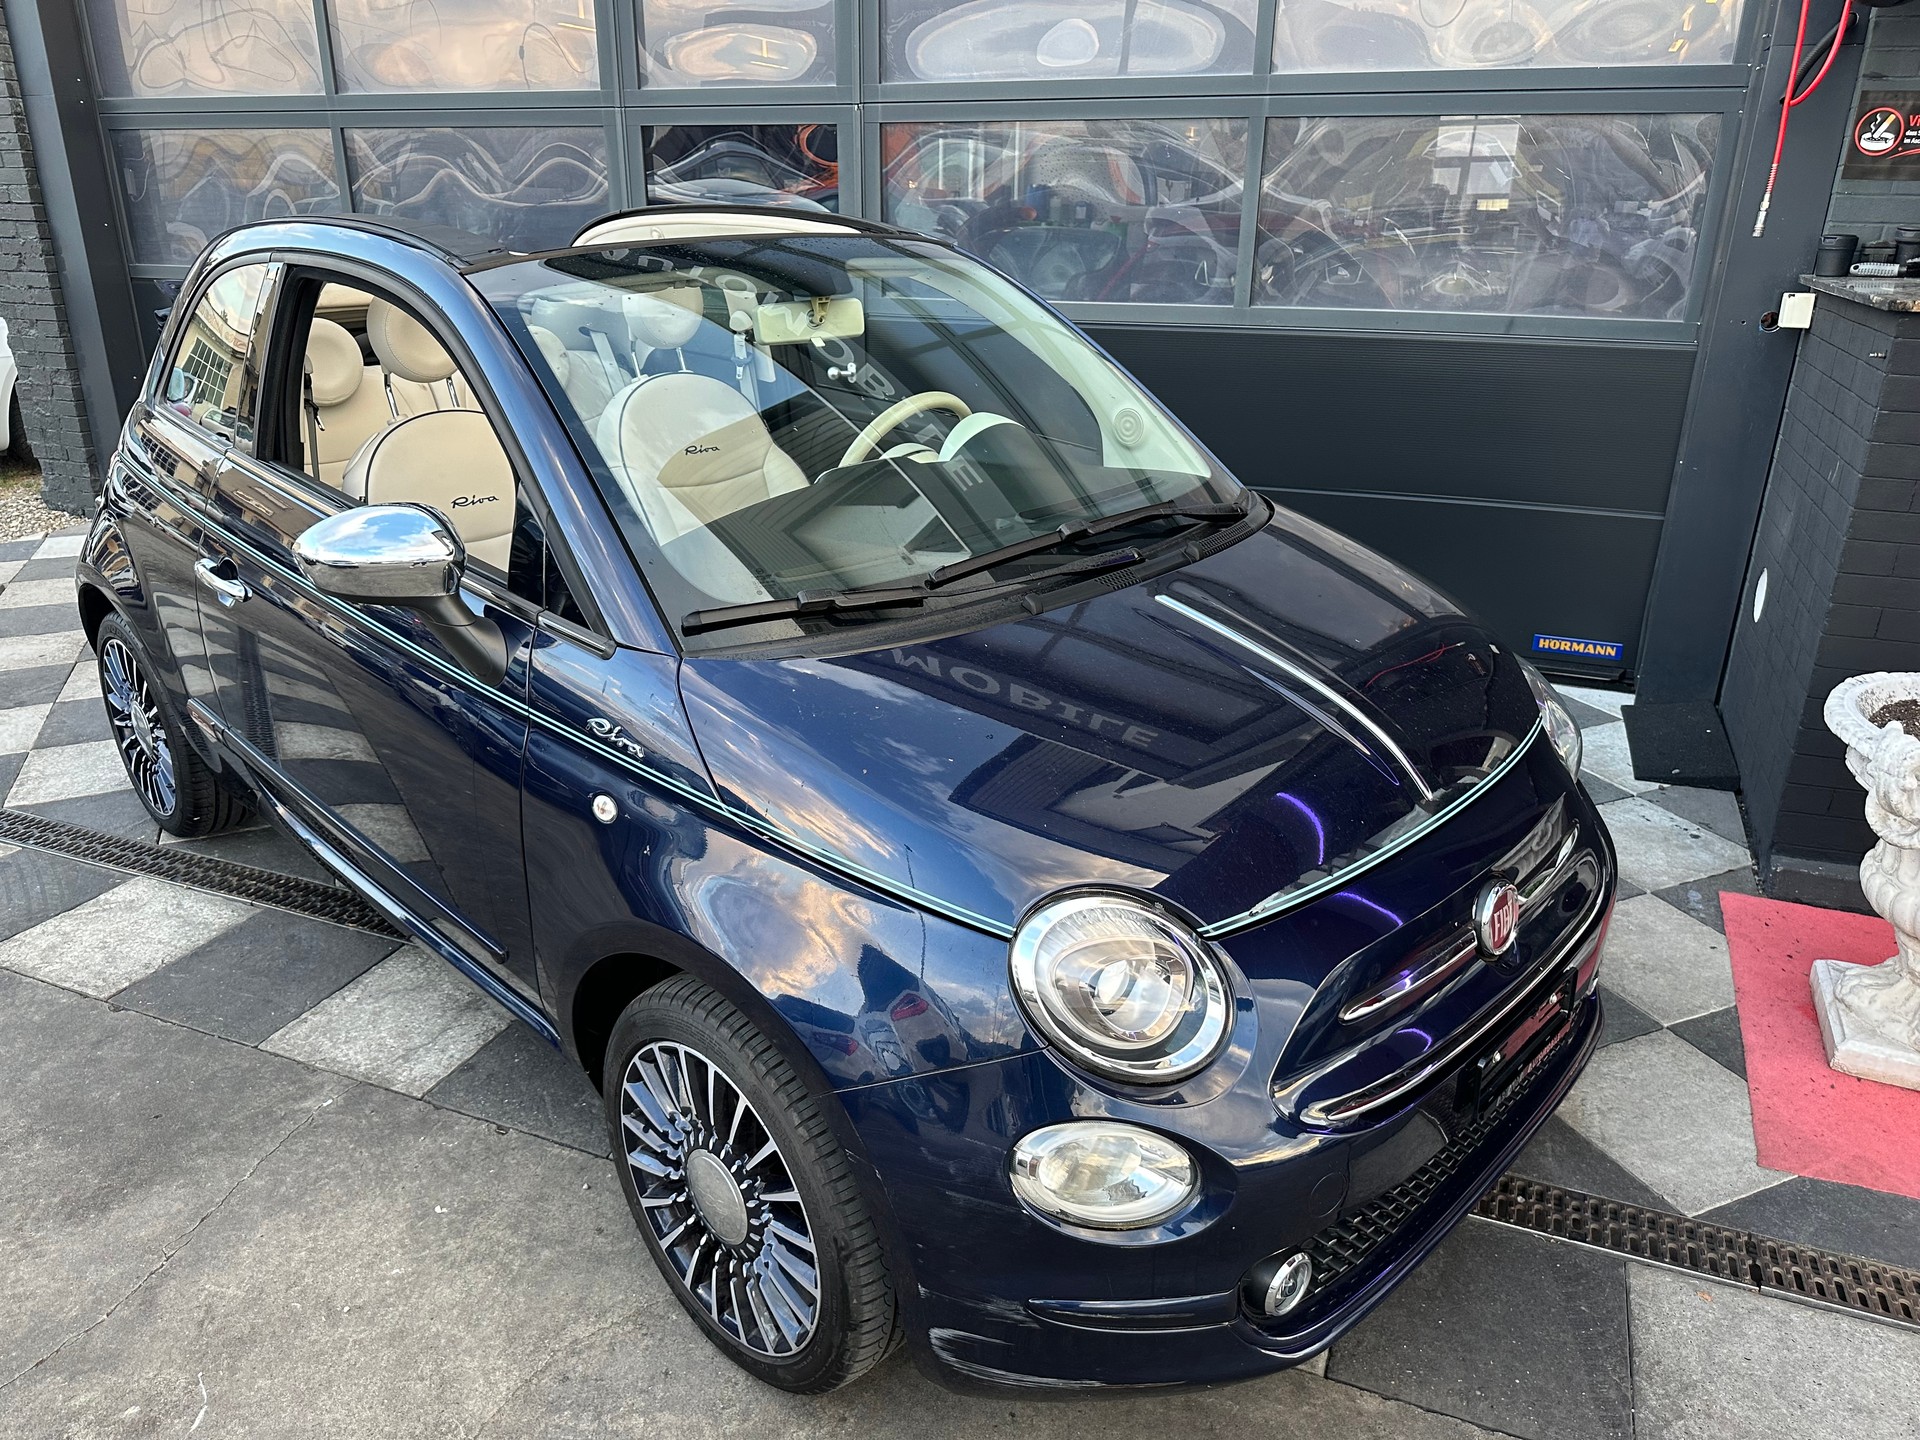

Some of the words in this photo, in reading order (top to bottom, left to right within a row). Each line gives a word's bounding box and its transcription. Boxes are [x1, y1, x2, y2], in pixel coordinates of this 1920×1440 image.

[684, 444, 720, 456] Riva
[451, 494, 500, 509] Riva
[1538, 638, 1617, 656] HÖRMANN
[1493, 899, 1513, 942] FIAT
